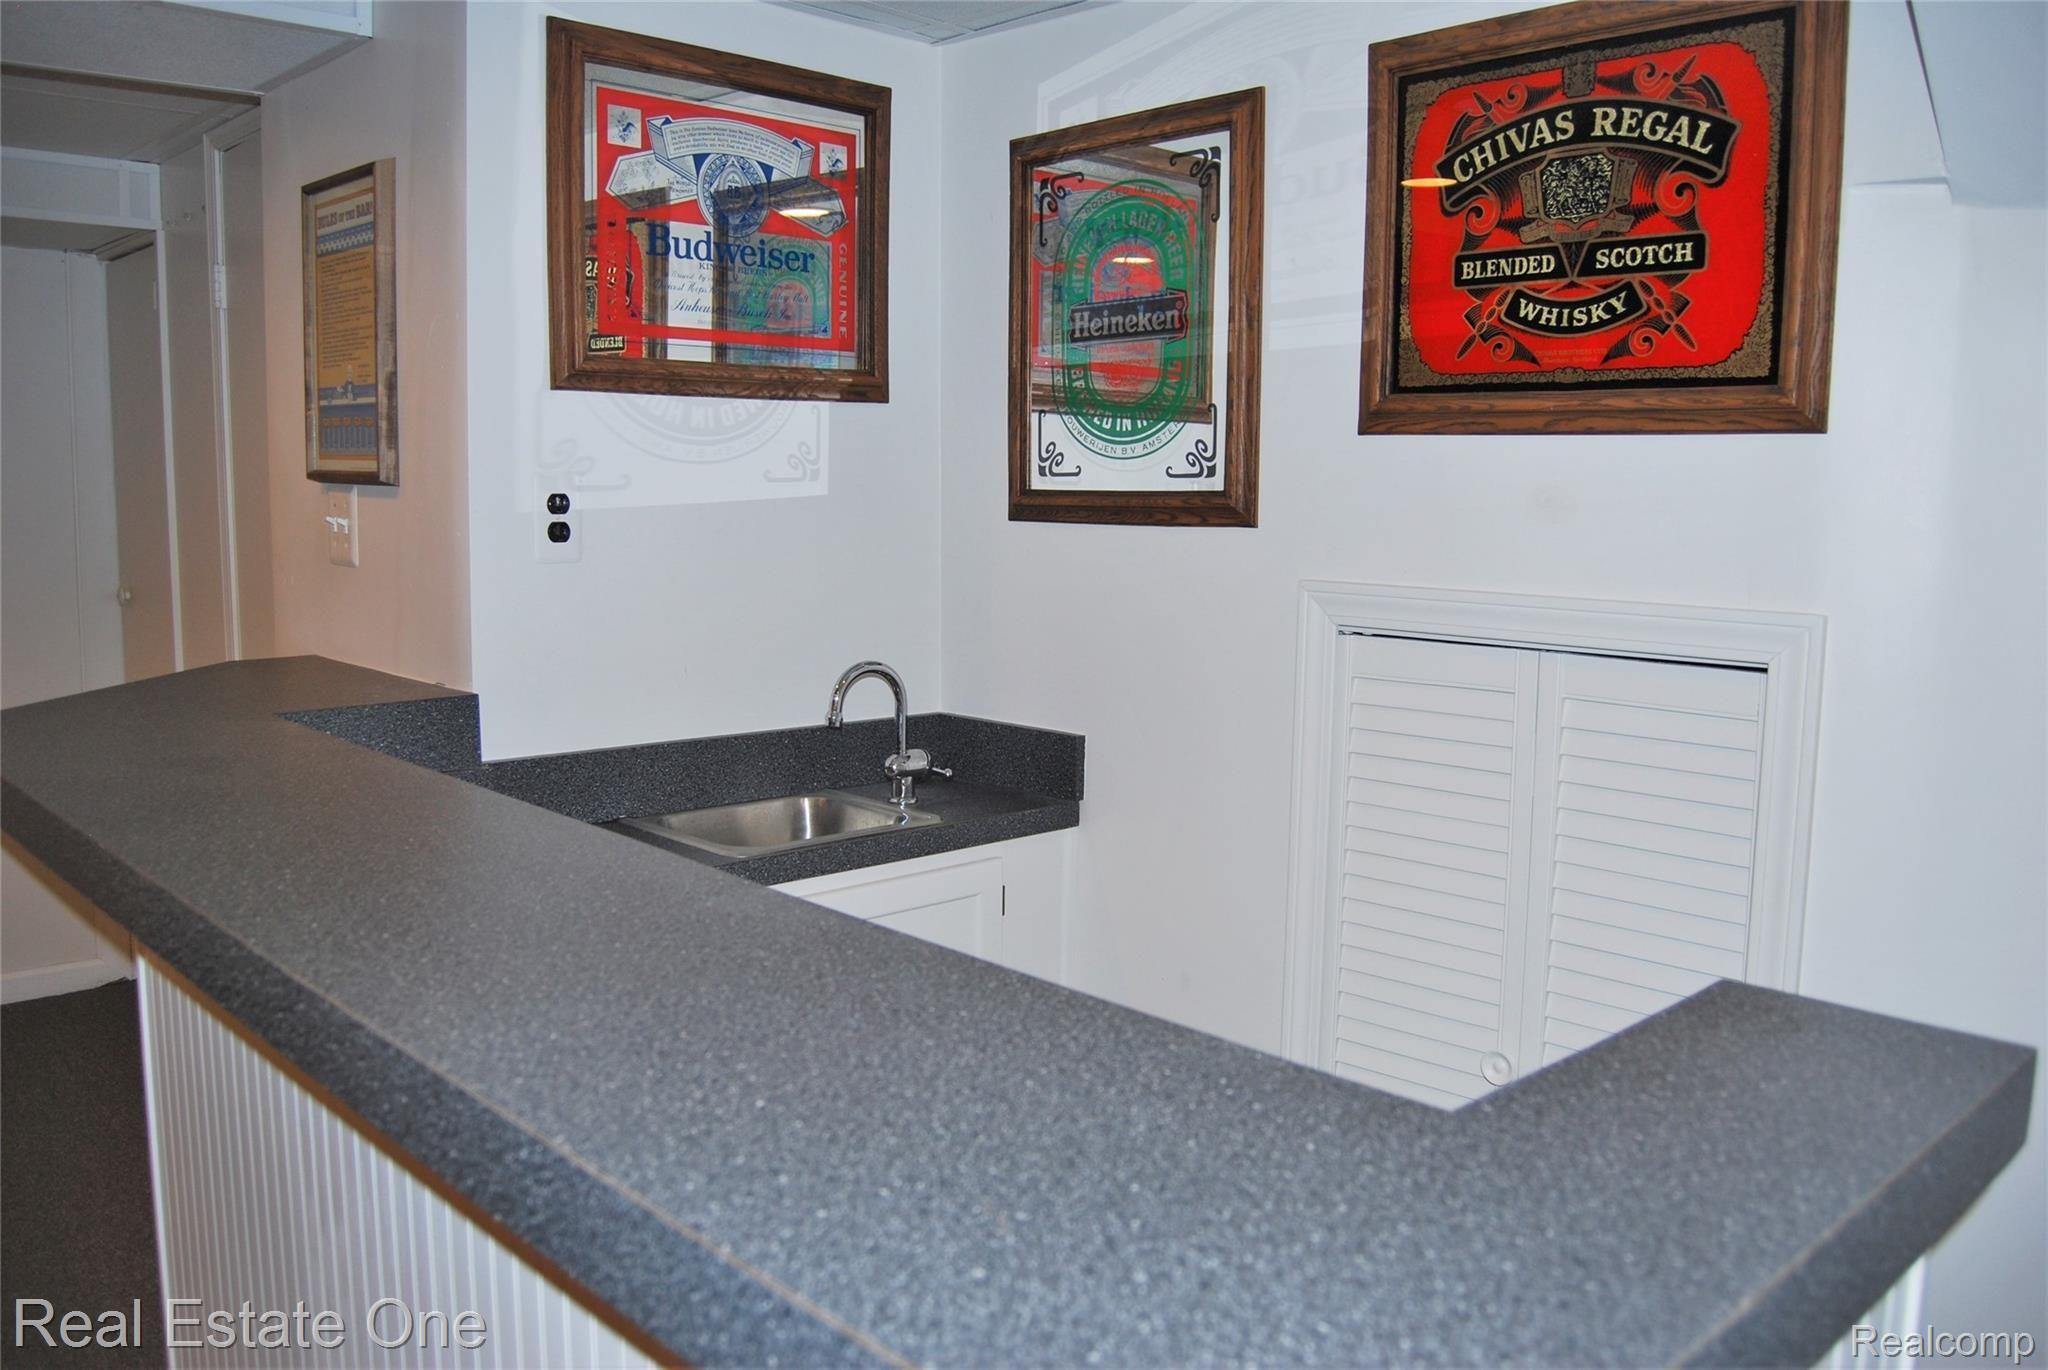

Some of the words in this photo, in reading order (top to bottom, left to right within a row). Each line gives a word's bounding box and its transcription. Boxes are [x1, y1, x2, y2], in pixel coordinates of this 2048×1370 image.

[1453, 106, 1576, 183] CHIVAS
[1590, 106, 1714, 155] REGAL
[647, 222, 815, 273] Budweiser
[1460, 254, 1555, 280] BLENDED
[1595, 241, 1695, 269] SCOTCH
[839, 243, 848, 339] GENUINE
[1518, 290, 1630, 328] WHISKY
[1073, 307, 1182, 339] Heineken
